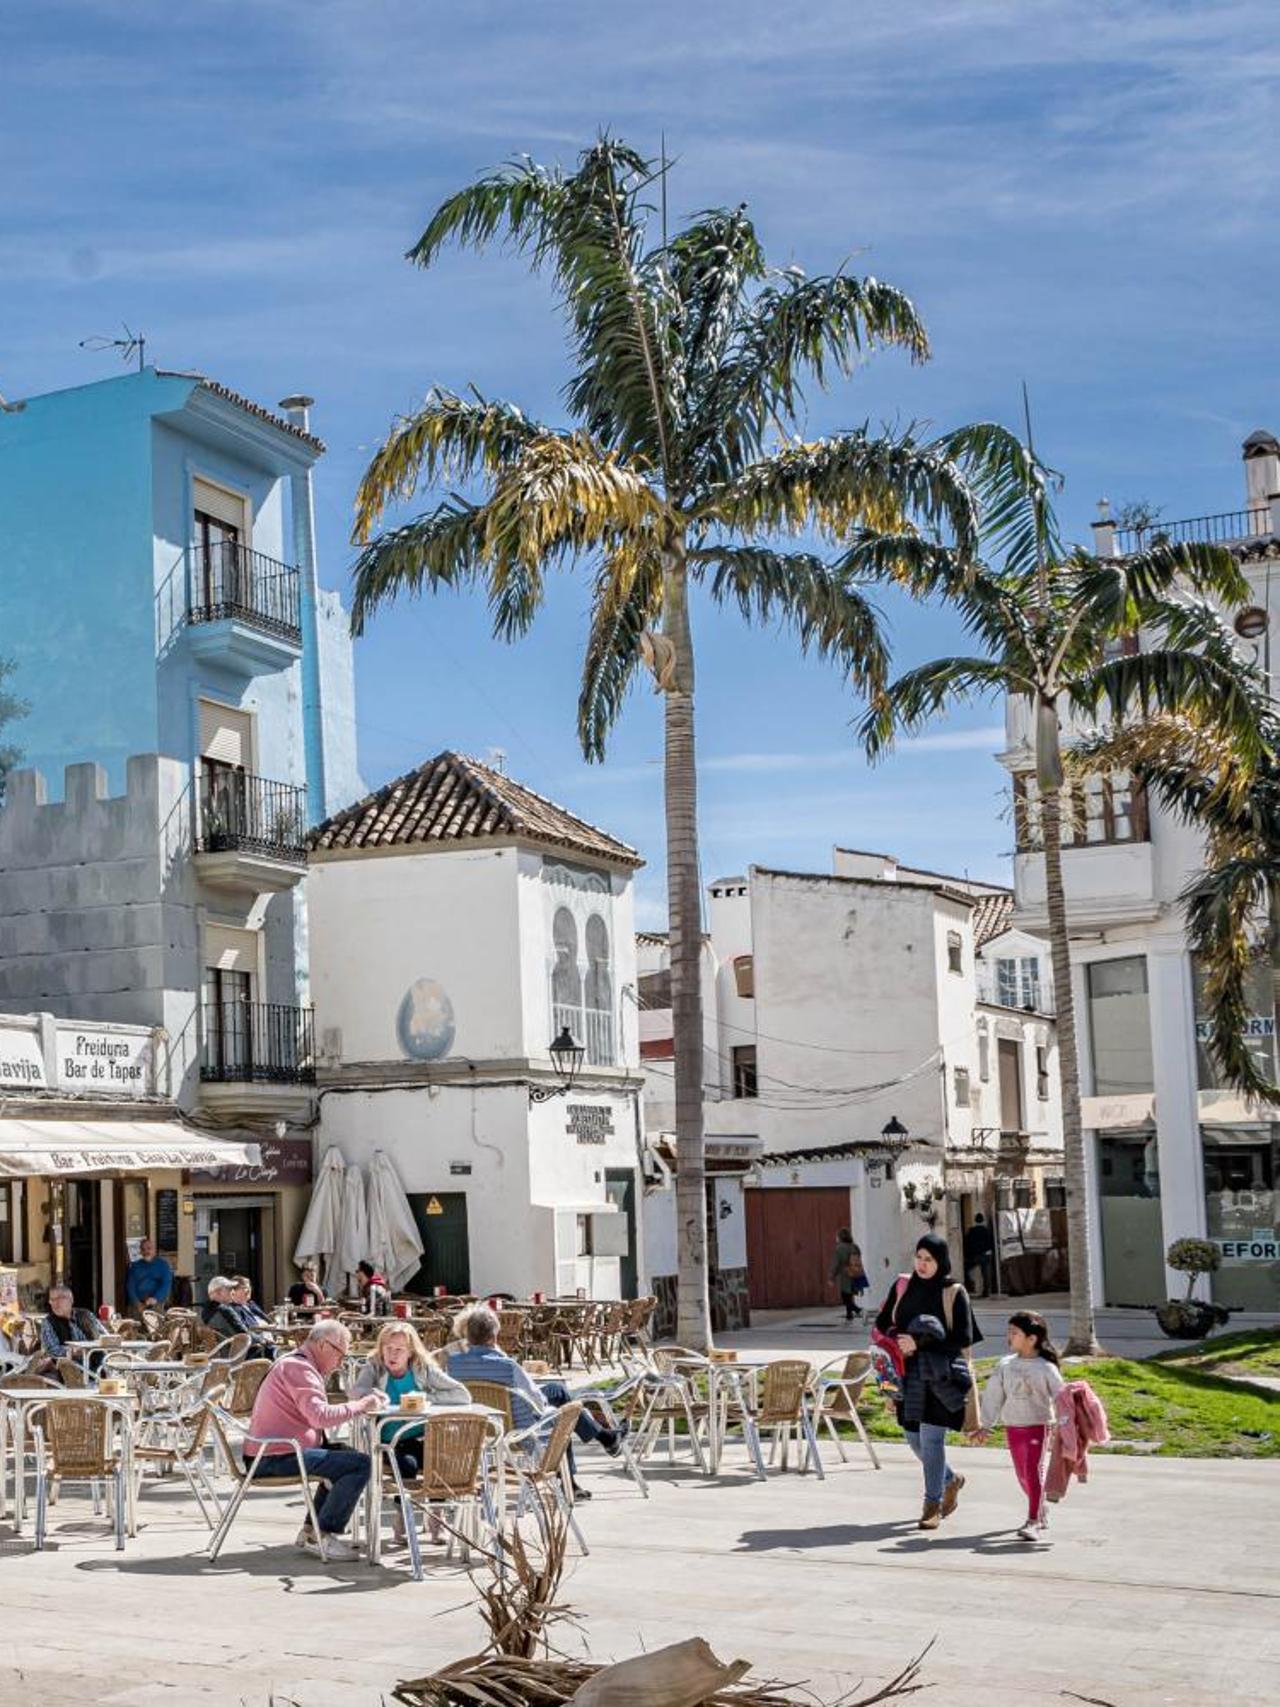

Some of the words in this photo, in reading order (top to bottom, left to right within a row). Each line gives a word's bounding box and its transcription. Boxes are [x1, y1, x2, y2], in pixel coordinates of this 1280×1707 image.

[64, 1057, 88, 1079] Bar
[91, 1059, 105, 1079] de
[108, 1059, 143, 1084] Tapas
[50, 1151, 75, 1169] Bar
[1215, 1242, 1280, 1258] EFOR
